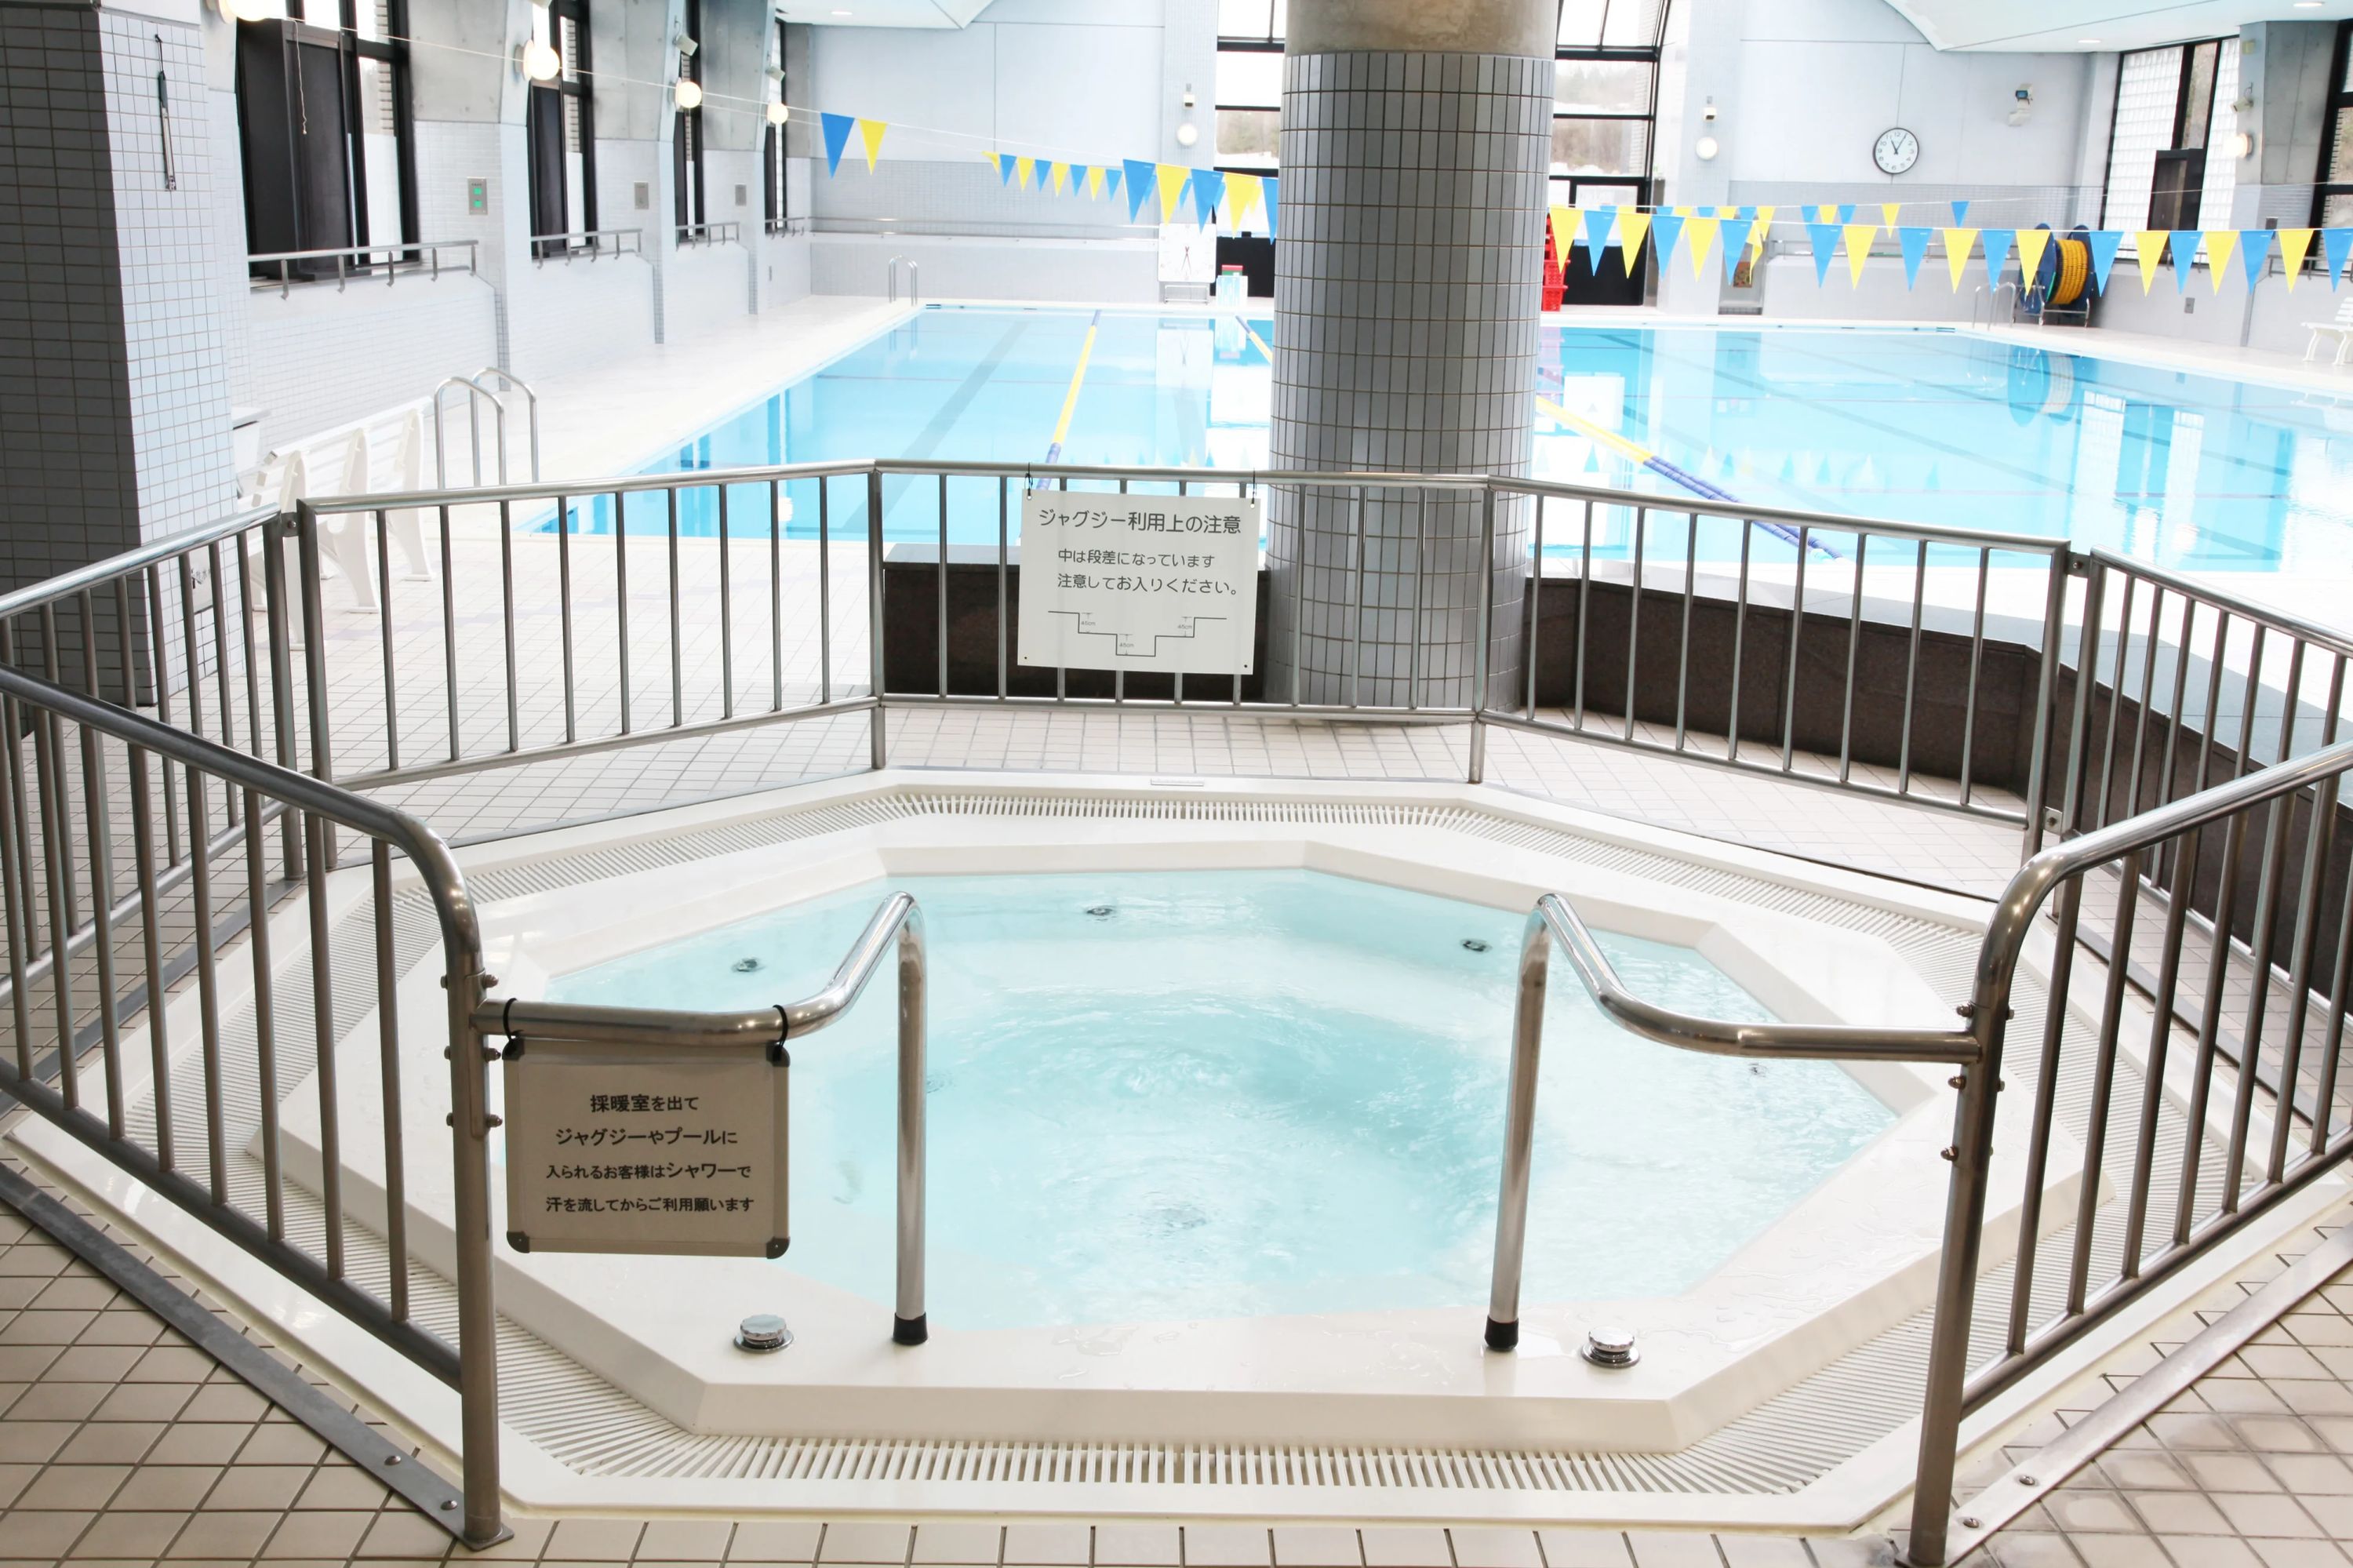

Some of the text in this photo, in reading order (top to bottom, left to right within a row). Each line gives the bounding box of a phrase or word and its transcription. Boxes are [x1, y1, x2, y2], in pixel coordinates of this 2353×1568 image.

[1039, 508, 1242, 535] ジャグジー利用上の注意
[1057, 548, 1216, 569] 中は段差になっています
[1057, 573, 1237, 596] 注意してお入りください。
[590, 1093, 700, 1113] 採暖室を出て
[555, 1126, 739, 1147] ジャグジーやプールに
[546, 1162, 751, 1181] 入られるお客様はシャワーで
[546, 1196, 755, 1213] 汗を流してからご利用願います
